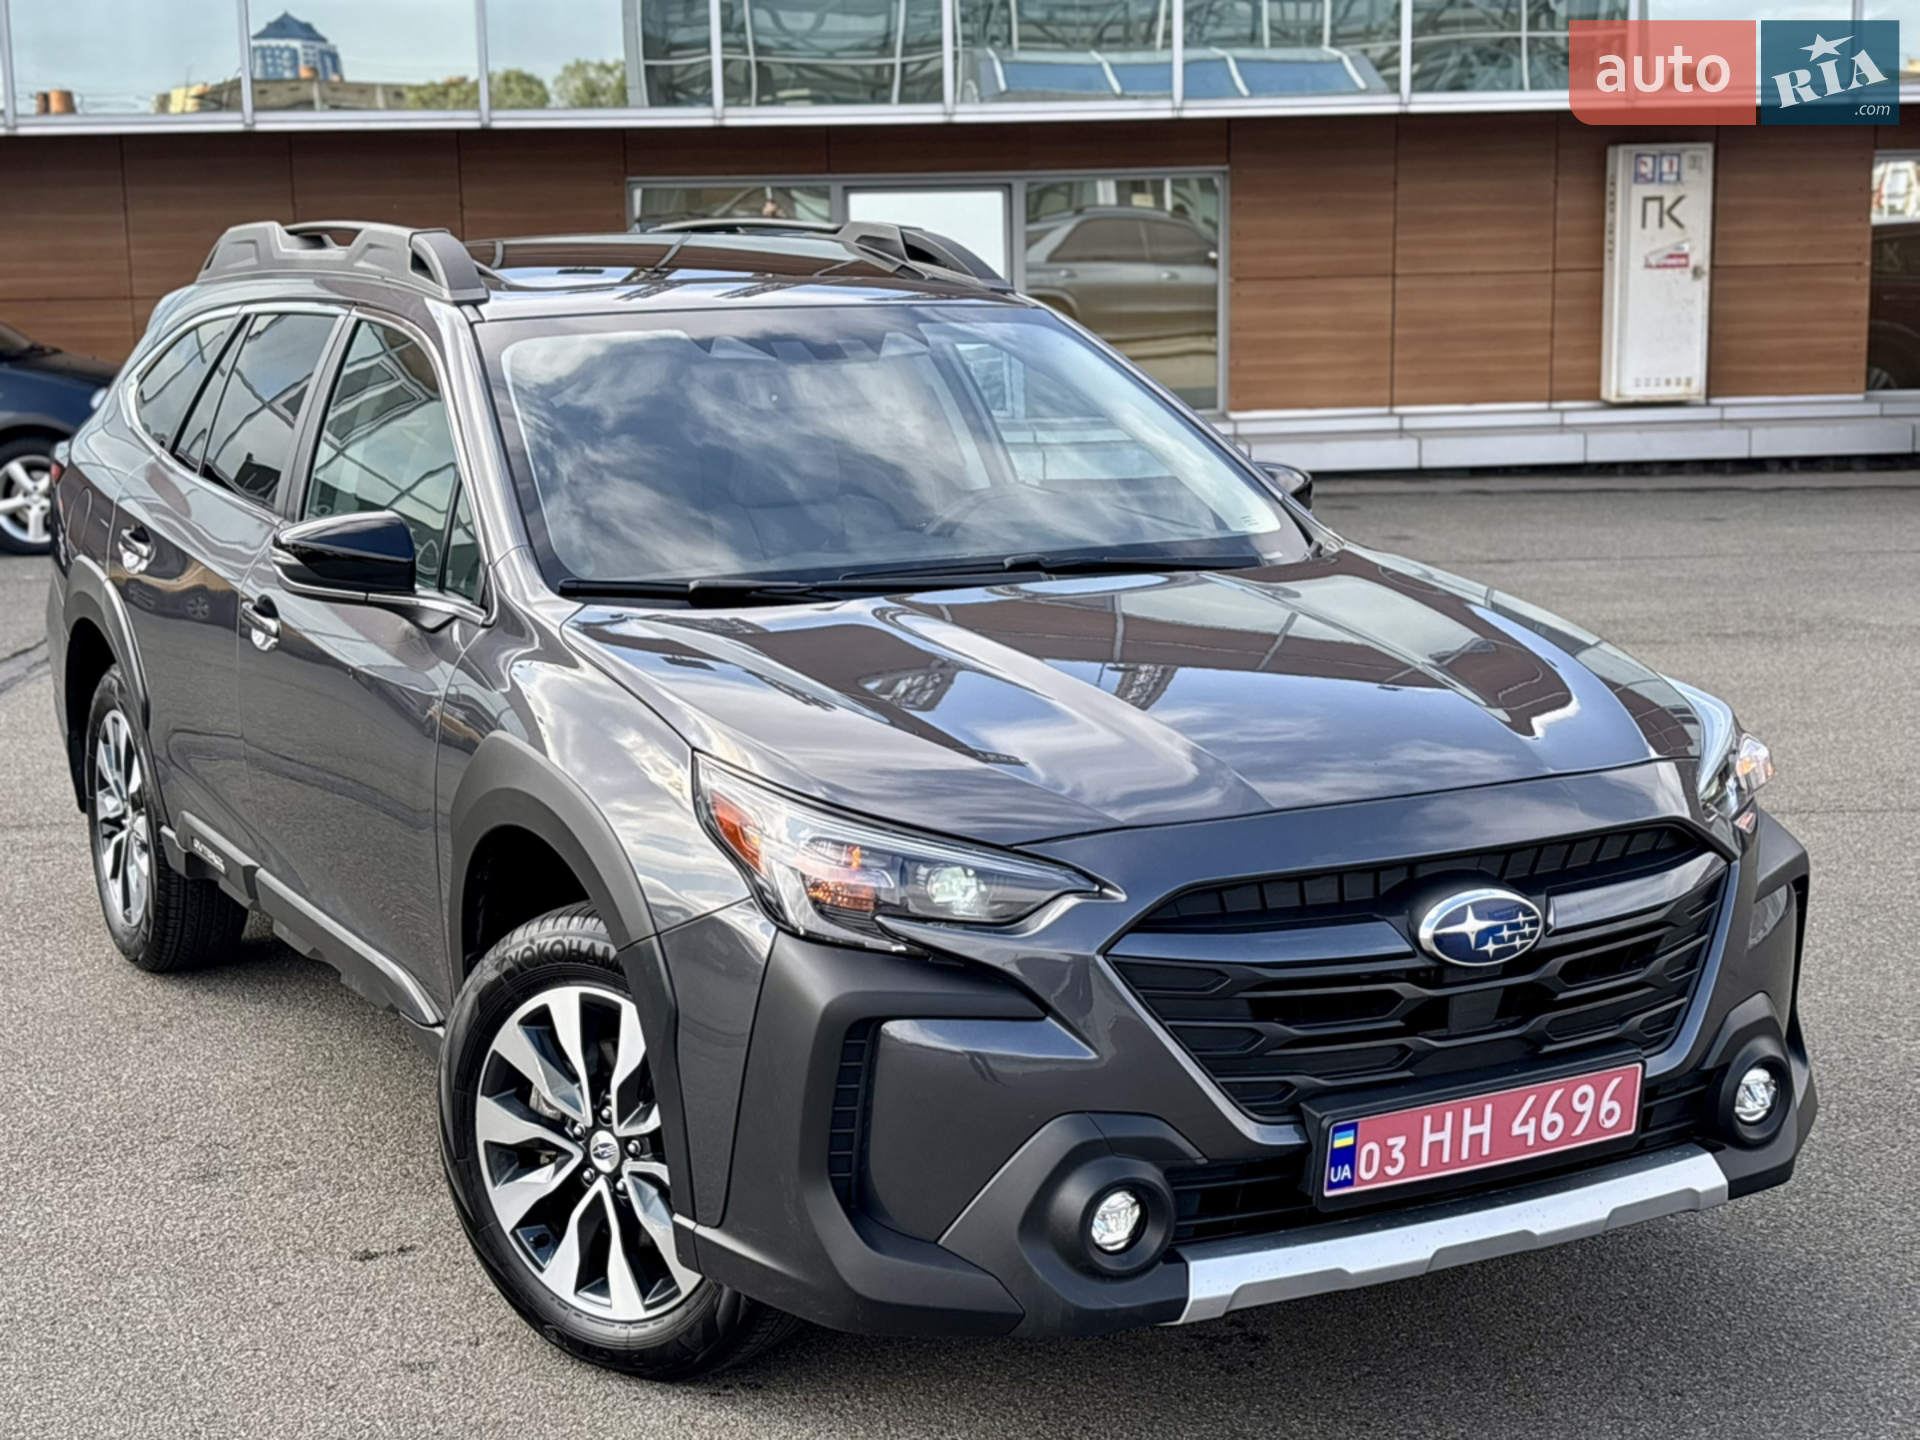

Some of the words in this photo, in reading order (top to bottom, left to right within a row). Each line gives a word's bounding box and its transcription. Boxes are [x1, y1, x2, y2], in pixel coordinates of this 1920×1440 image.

[508, 939, 626, 977] YOKOHAM
[1358, 1135, 1407, 1181] 03
[1420, 1103, 1492, 1167] HH
[1511, 1076, 1623, 1147] 4696
[1330, 1164, 1352, 1182] UA
